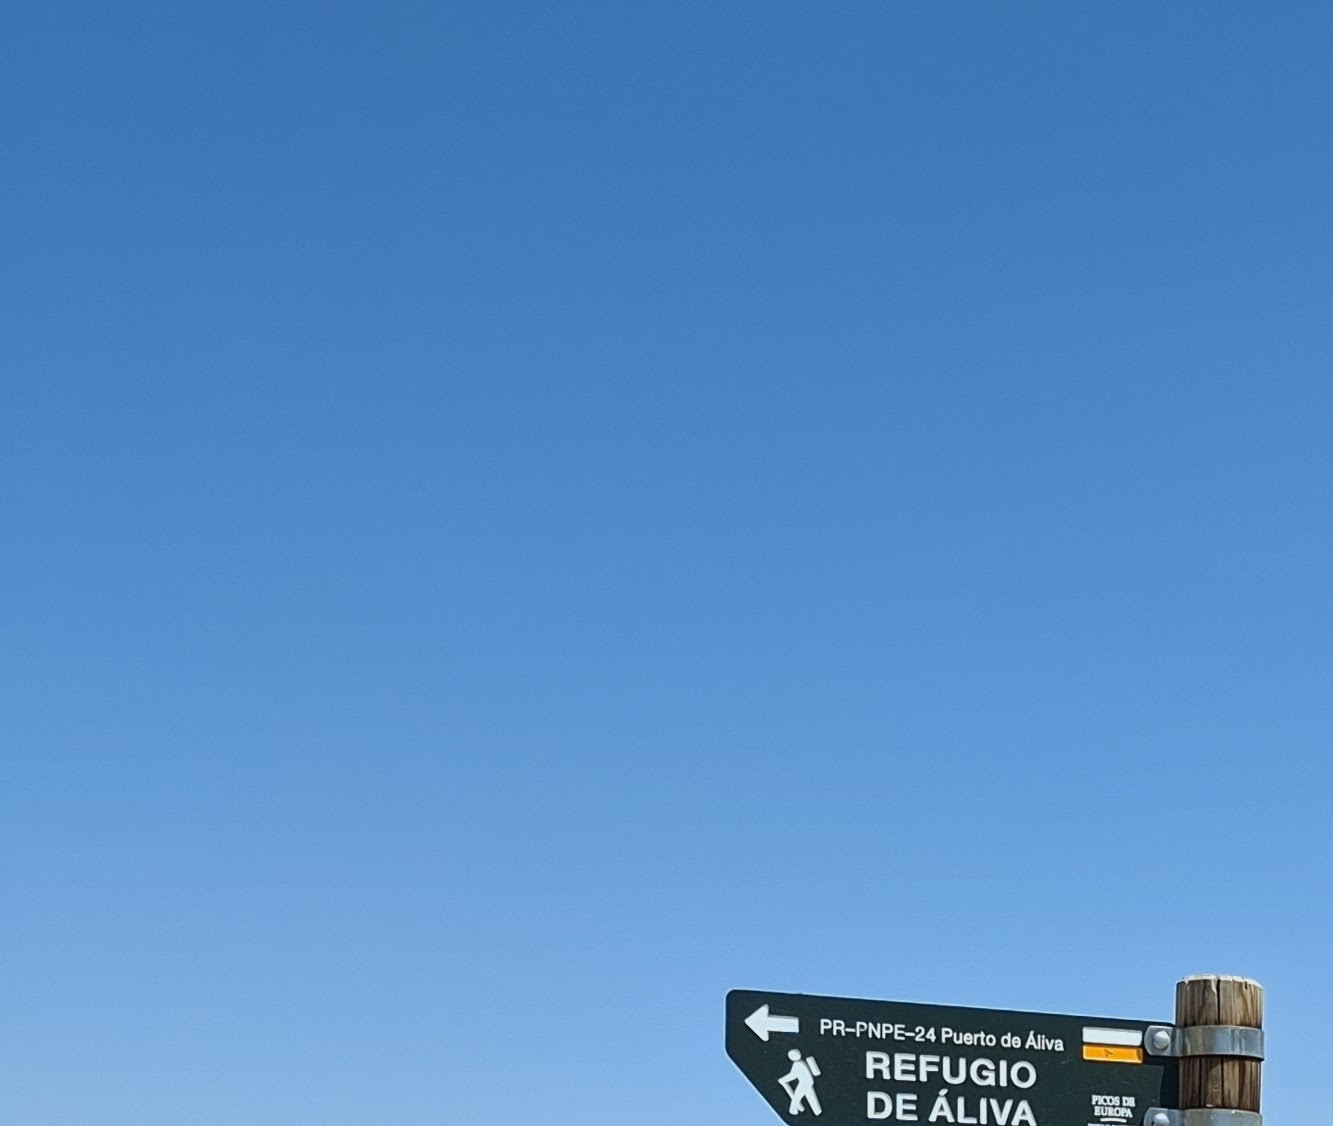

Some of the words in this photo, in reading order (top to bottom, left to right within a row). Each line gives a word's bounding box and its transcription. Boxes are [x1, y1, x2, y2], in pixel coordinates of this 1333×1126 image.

[941, 1027, 997, 1047] Puerto
[1000, 1032, 1022, 1049] de
[1025, 1030, 1065, 1052] Áliva
[865, 1050, 1038, 1089] REFUGIO
[866, 1091, 919, 1121] DE
[928, 1088, 1038, 1126] ÁLIVA
[1091, 1094, 1120, 1106] PICOS
[1122, 1096, 1136, 1107] DE
[1094, 1105, 1133, 1118] EUROPA
